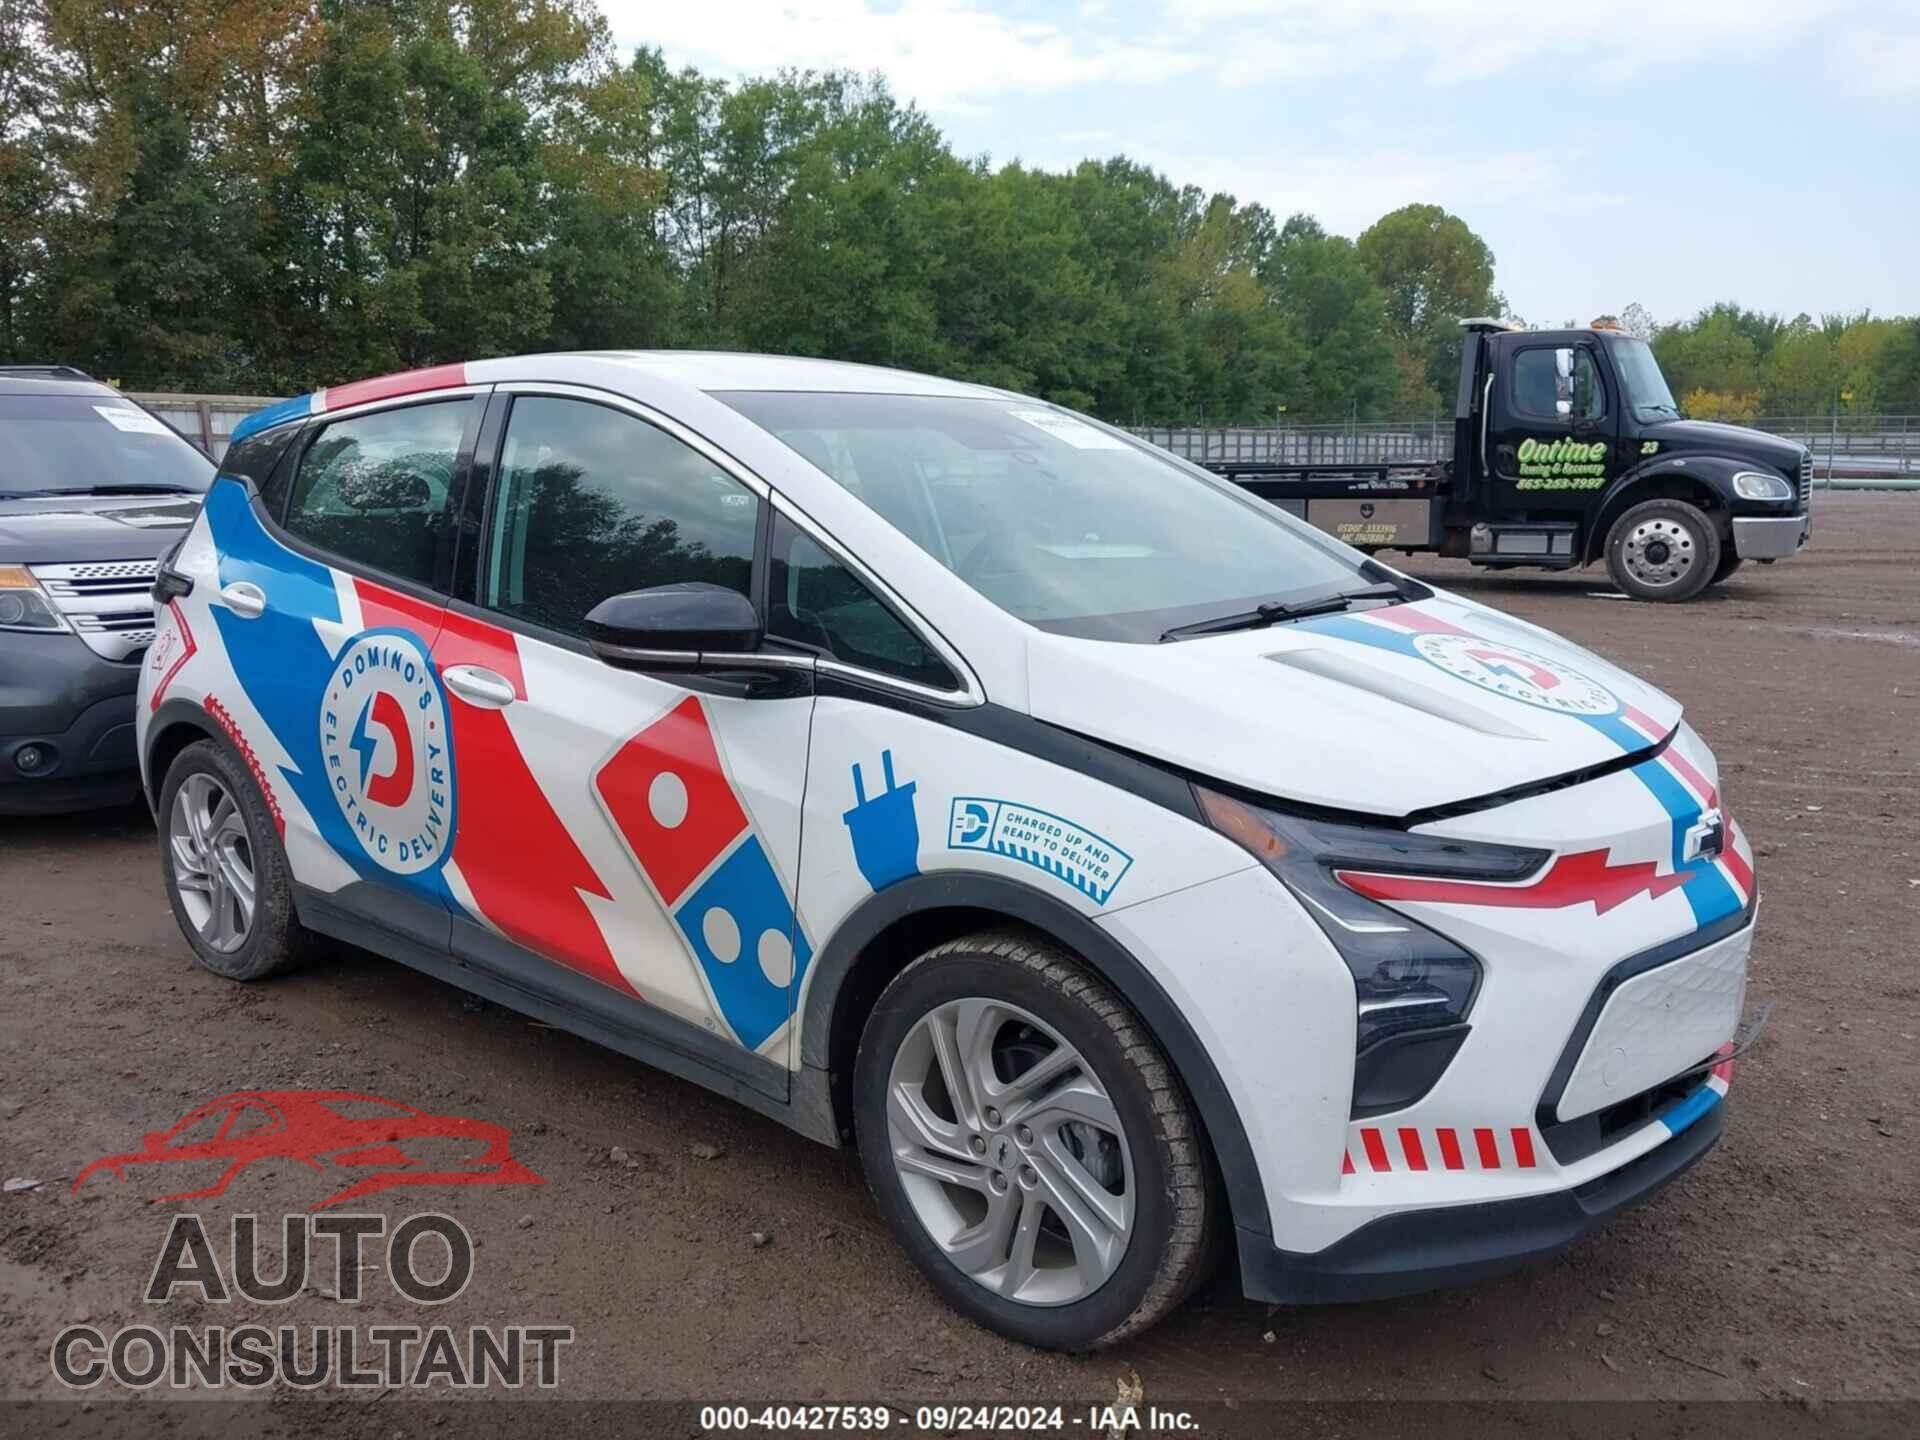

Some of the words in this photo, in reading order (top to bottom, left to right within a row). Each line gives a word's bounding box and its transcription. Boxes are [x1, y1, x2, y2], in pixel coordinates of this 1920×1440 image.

[1518, 436, 1607, 463] Ontime
[1519, 463, 1550, 477] Towing
[1551, 462, 1562, 474] &
[1562, 462, 1606, 476] Recovery
[1640, 441, 1659, 454] 23
[342, 646, 432, 711] DOMINO'S
[326, 711, 389, 854] ELECTRIC
[399, 744, 445, 863] DELIVERY
[1002, 825, 1041, 844] READY
[1044, 838, 1058, 851] TO
[1061, 847, 1110, 882] DELIVER
[1006, 812, 1062, 838] CHARGED
[1066, 832, 1083, 846] UP
[1084, 844, 1110, 864] AND
